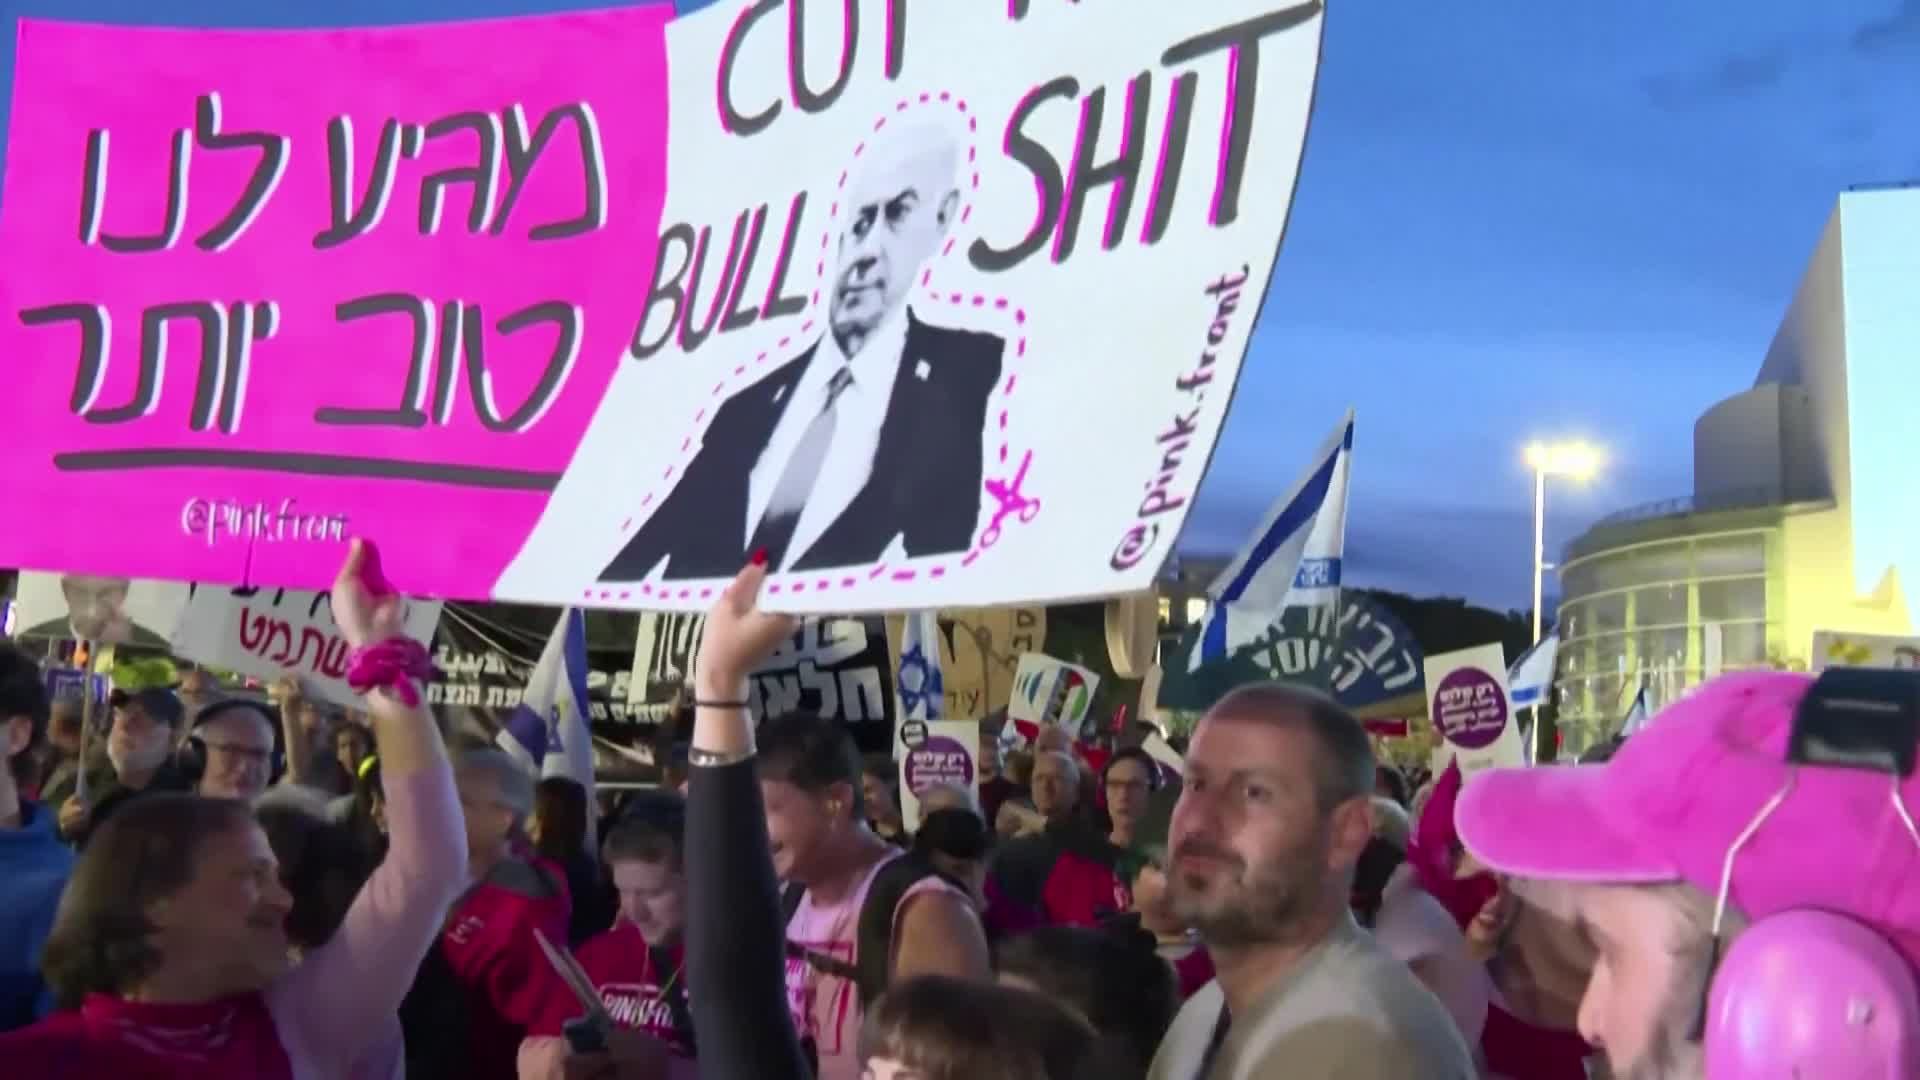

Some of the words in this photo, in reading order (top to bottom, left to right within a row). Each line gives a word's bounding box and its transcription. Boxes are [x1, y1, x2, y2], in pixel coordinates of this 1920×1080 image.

[79, 91, 291, 253] לנו
[312, 101, 608, 249] מגיע
[631, 191, 807, 359] BULL
[968, 2, 1323, 272] SHIT
[18, 300, 281, 435] יותר
[313, 293, 584, 434] טוב
[240, 607, 348, 680] שתמט
